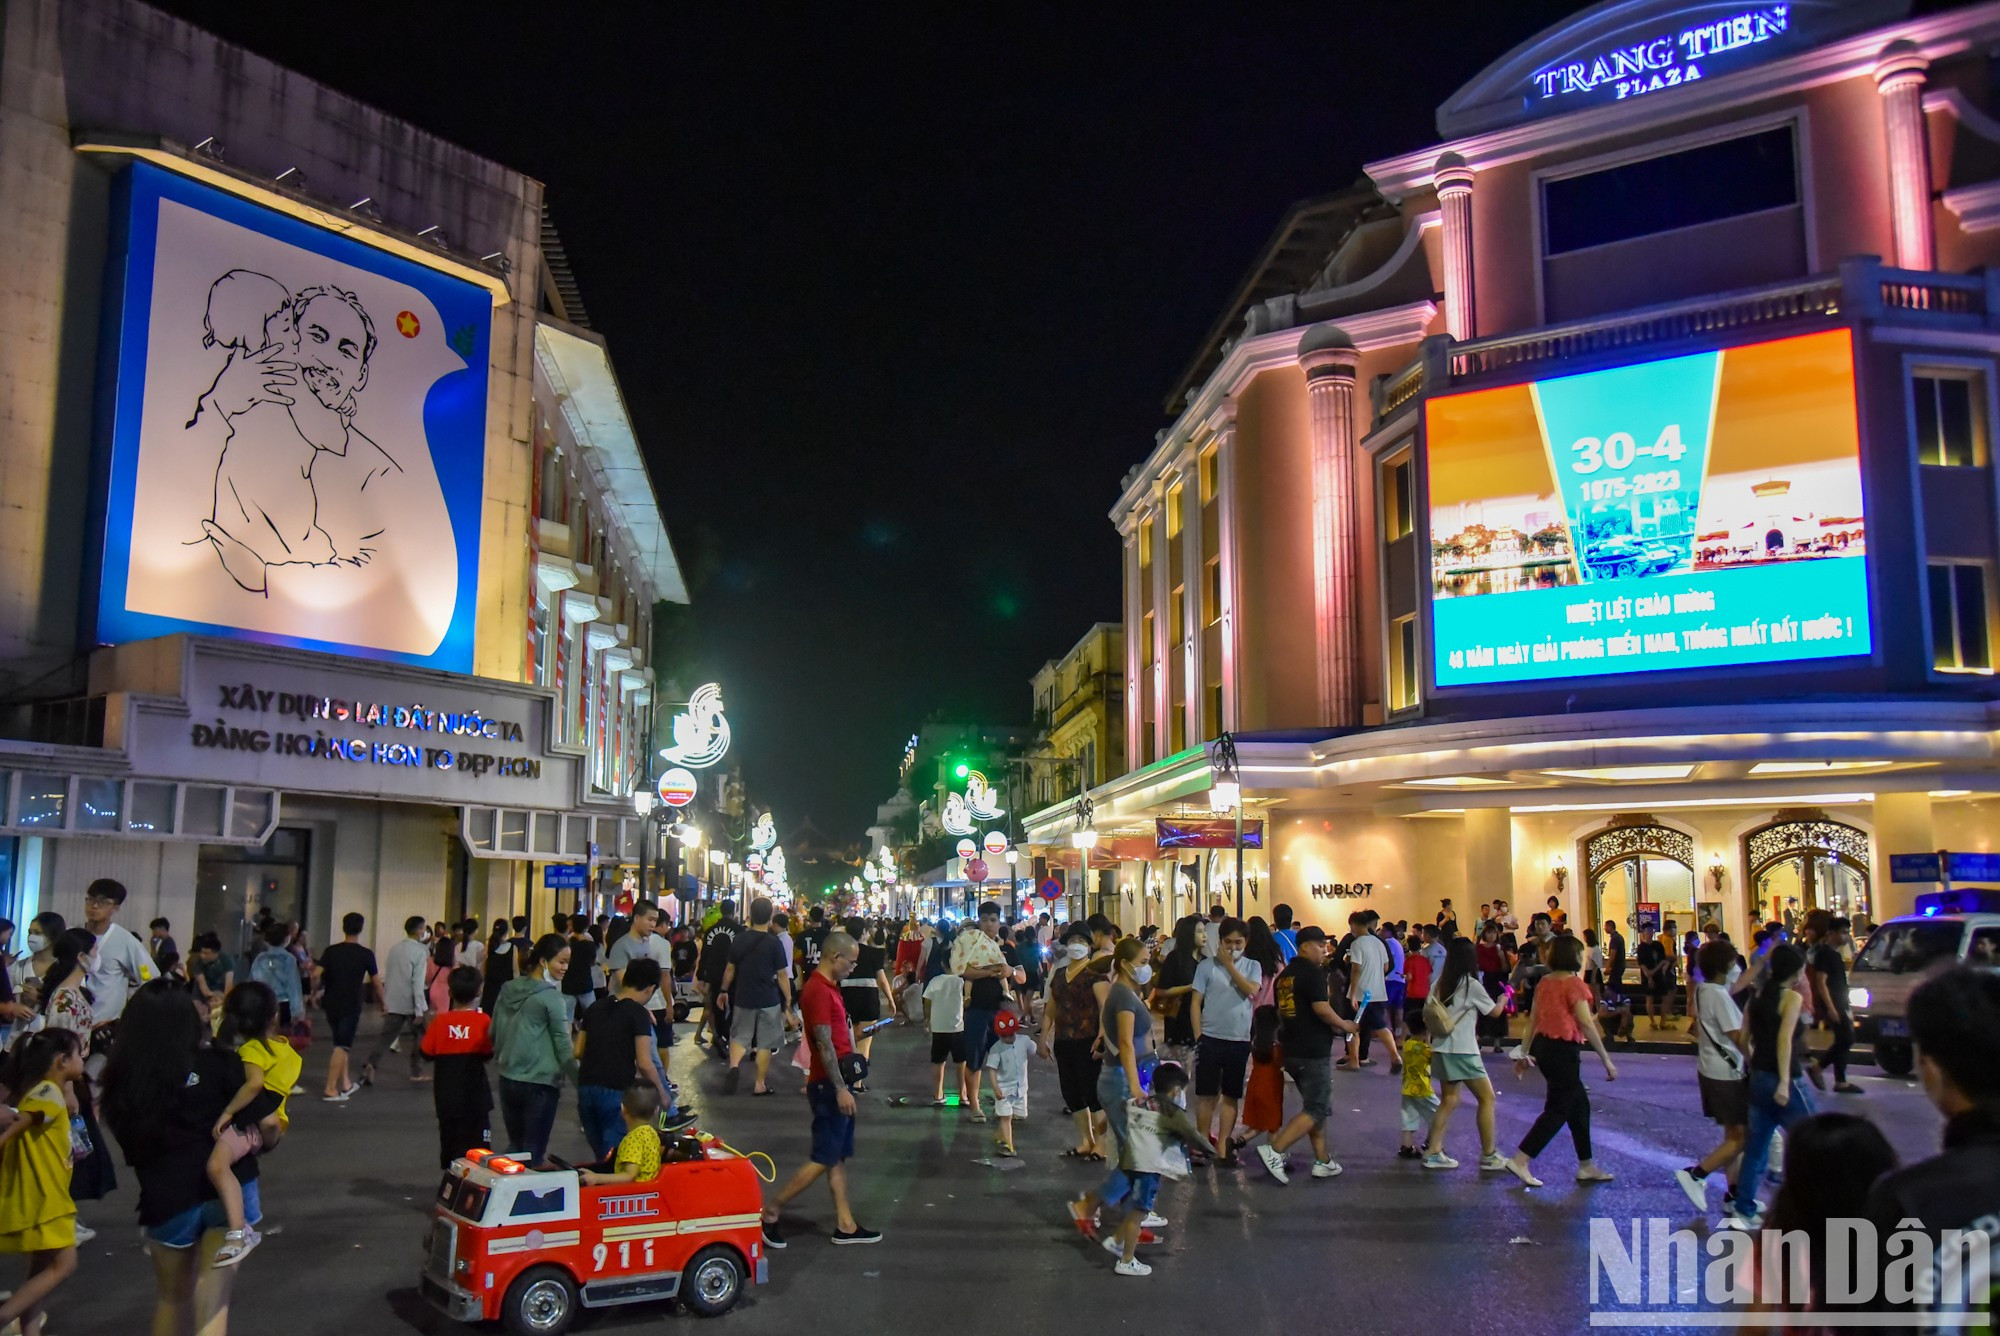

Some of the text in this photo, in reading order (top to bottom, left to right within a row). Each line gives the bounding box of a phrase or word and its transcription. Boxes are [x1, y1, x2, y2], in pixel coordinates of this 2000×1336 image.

[1534, 36, 1673, 98] TRANG
[1616, 63, 1702, 99] PLAZA
[1571, 424, 1686, 474] 30-4
[1580, 470, 1680, 501] 1975-2023
[1606, 596, 1632, 623] LIỆT
[1497, 641, 1530, 666] NGÀY
[219, 683, 275, 712] XÂY
[278, 691, 349, 722] DỰNG
[355, 701, 389, 729] LẠI
[437, 709, 498, 739] NƯỚC
[501, 721, 524, 742] TA
[191, 718, 271, 753] ĐÀNG
[275, 730, 367, 761] HOÀNG
[425, 747, 454, 770] TO
[457, 752, 495, 778] ĐẸP
[1311, 882, 1373, 896] HUBLOT
[592, 1239, 655, 1272] 911
